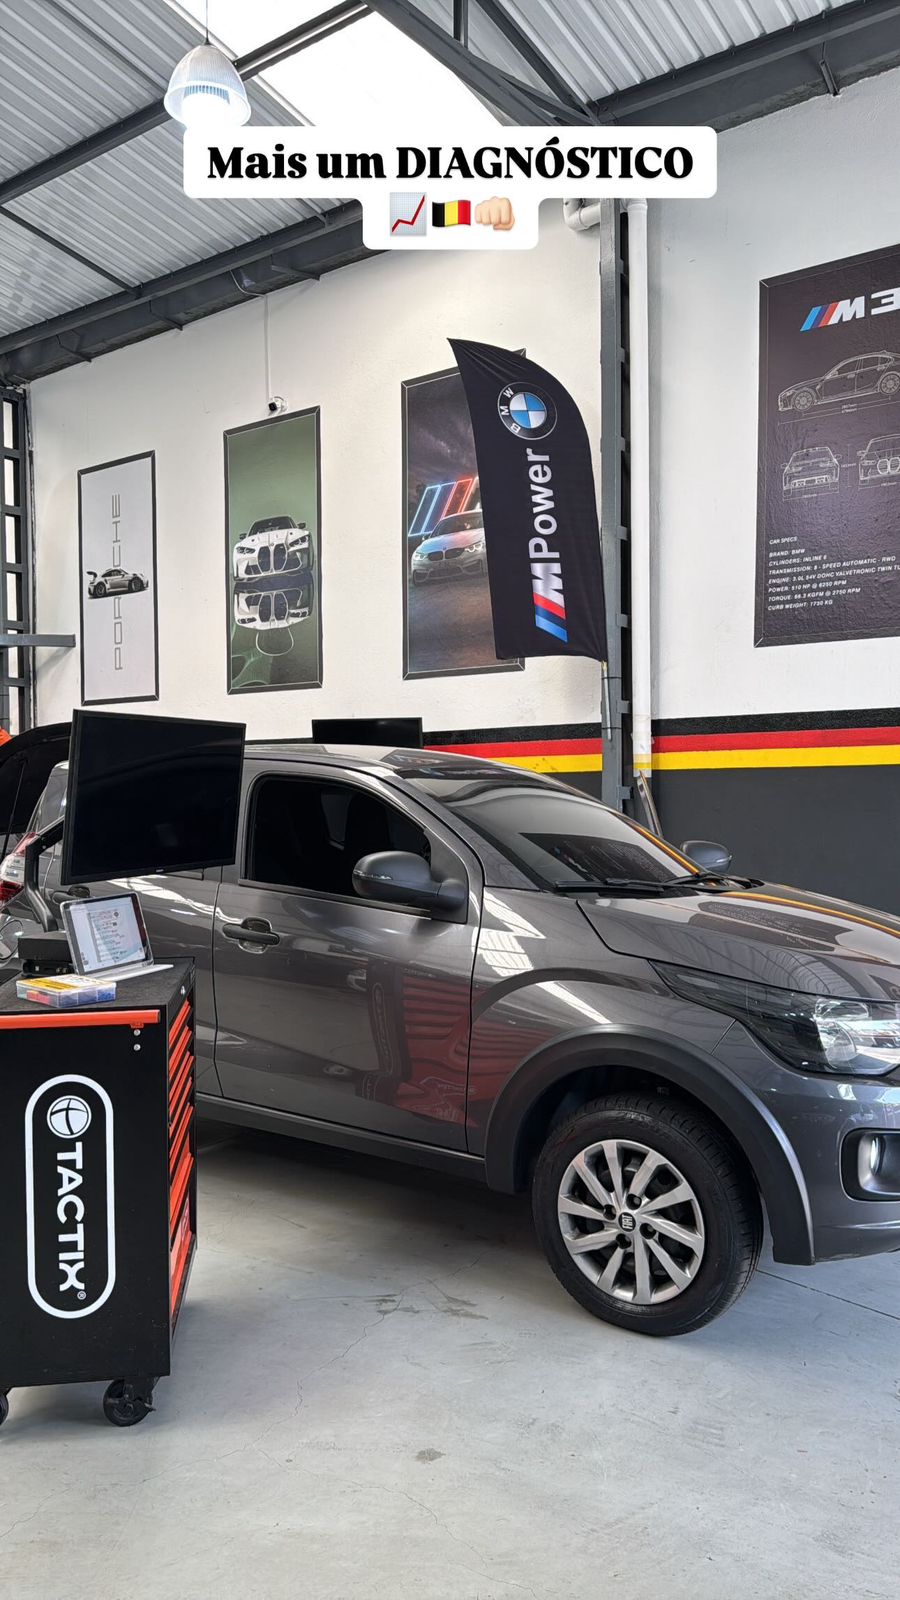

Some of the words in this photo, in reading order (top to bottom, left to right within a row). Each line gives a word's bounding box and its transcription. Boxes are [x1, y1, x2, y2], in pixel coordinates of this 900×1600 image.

[111, 494, 123, 670] PORCHE
[822, 562, 841, 570] SPEED
[842, 558, 877, 567] AUTOMATIC
